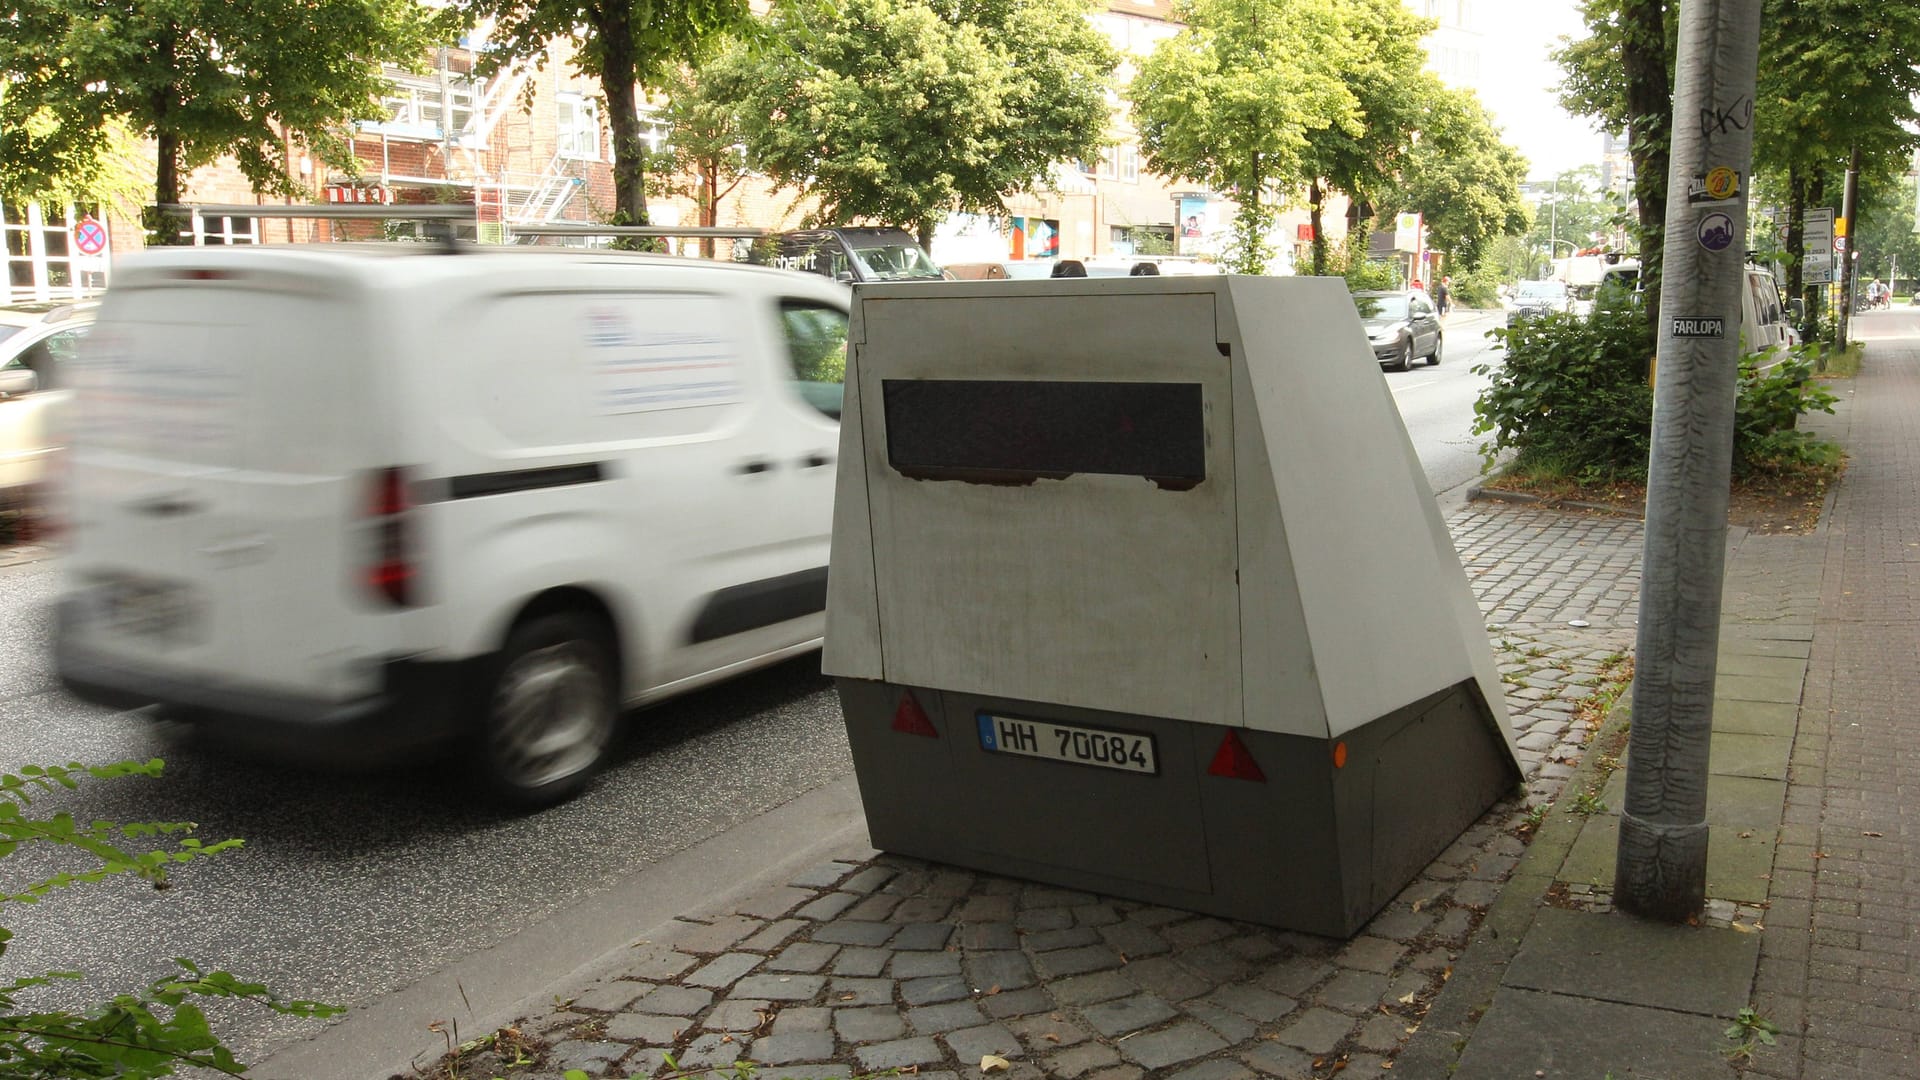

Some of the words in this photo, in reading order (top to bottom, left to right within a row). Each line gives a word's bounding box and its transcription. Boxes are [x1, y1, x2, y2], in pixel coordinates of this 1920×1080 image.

[1673, 320, 1722, 335] FARLOPA
[999, 721, 1038, 753] HH
[1054, 729, 1147, 768] 70084
